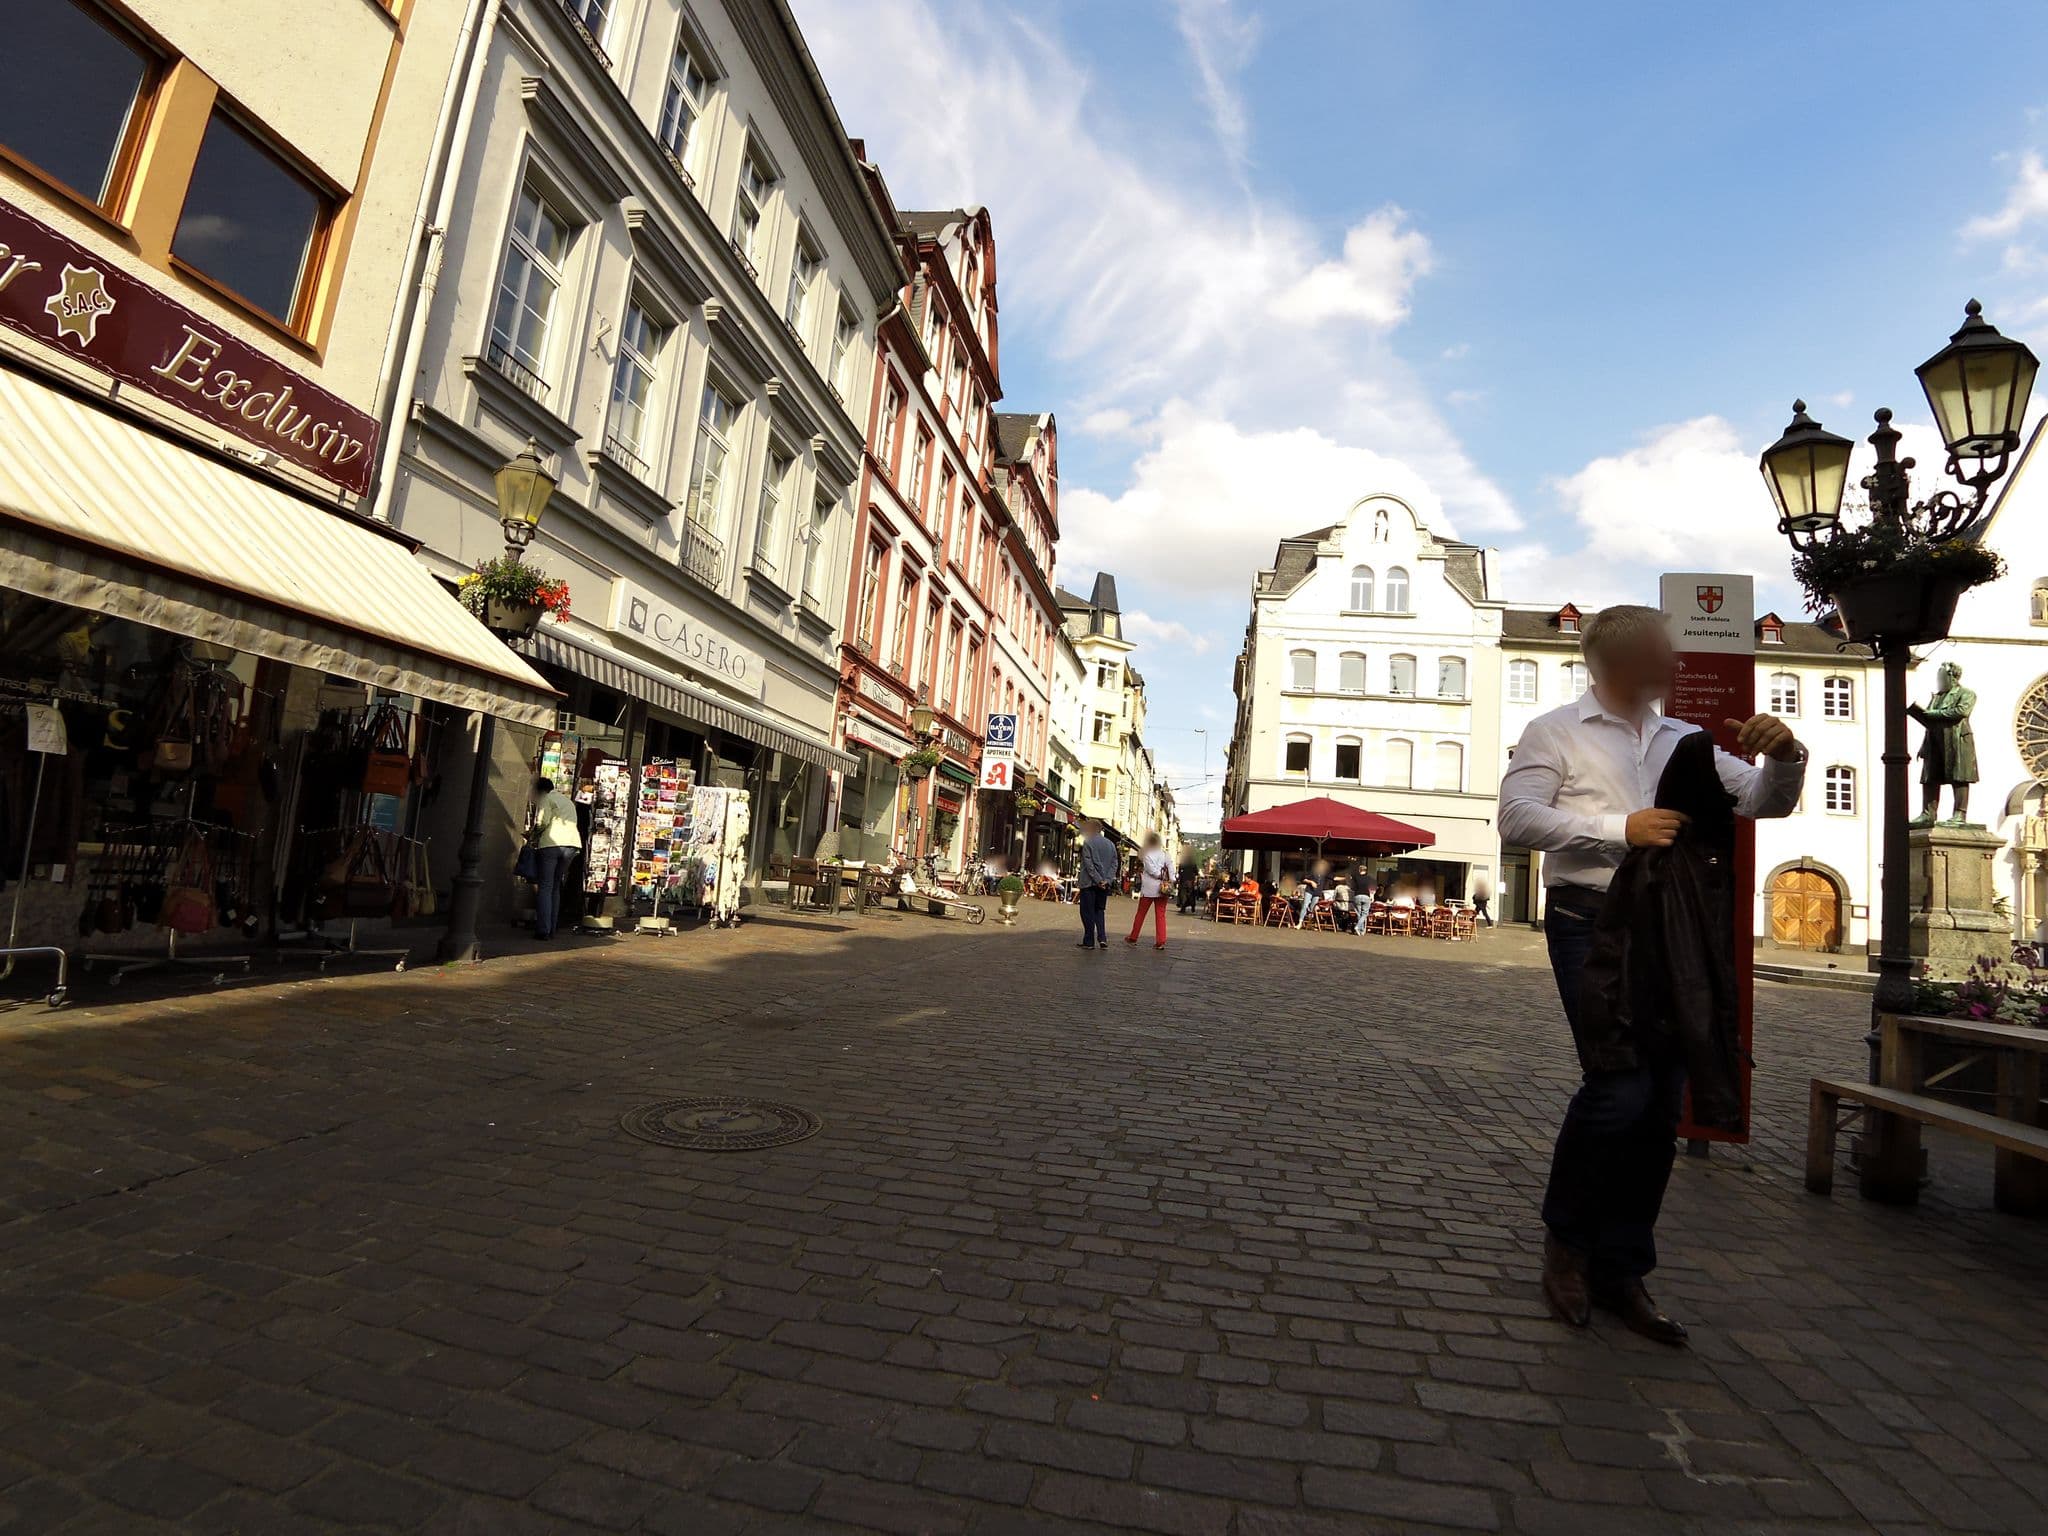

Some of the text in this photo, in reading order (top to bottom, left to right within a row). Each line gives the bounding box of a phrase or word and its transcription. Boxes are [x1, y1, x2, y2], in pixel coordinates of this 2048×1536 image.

[61, 286, 108, 317] S.A.C.
[151, 324, 365, 465] Exclusiv
[654, 613, 746, 679] CASERO
[1683, 629, 1740, 639] Jesuitenplatz
